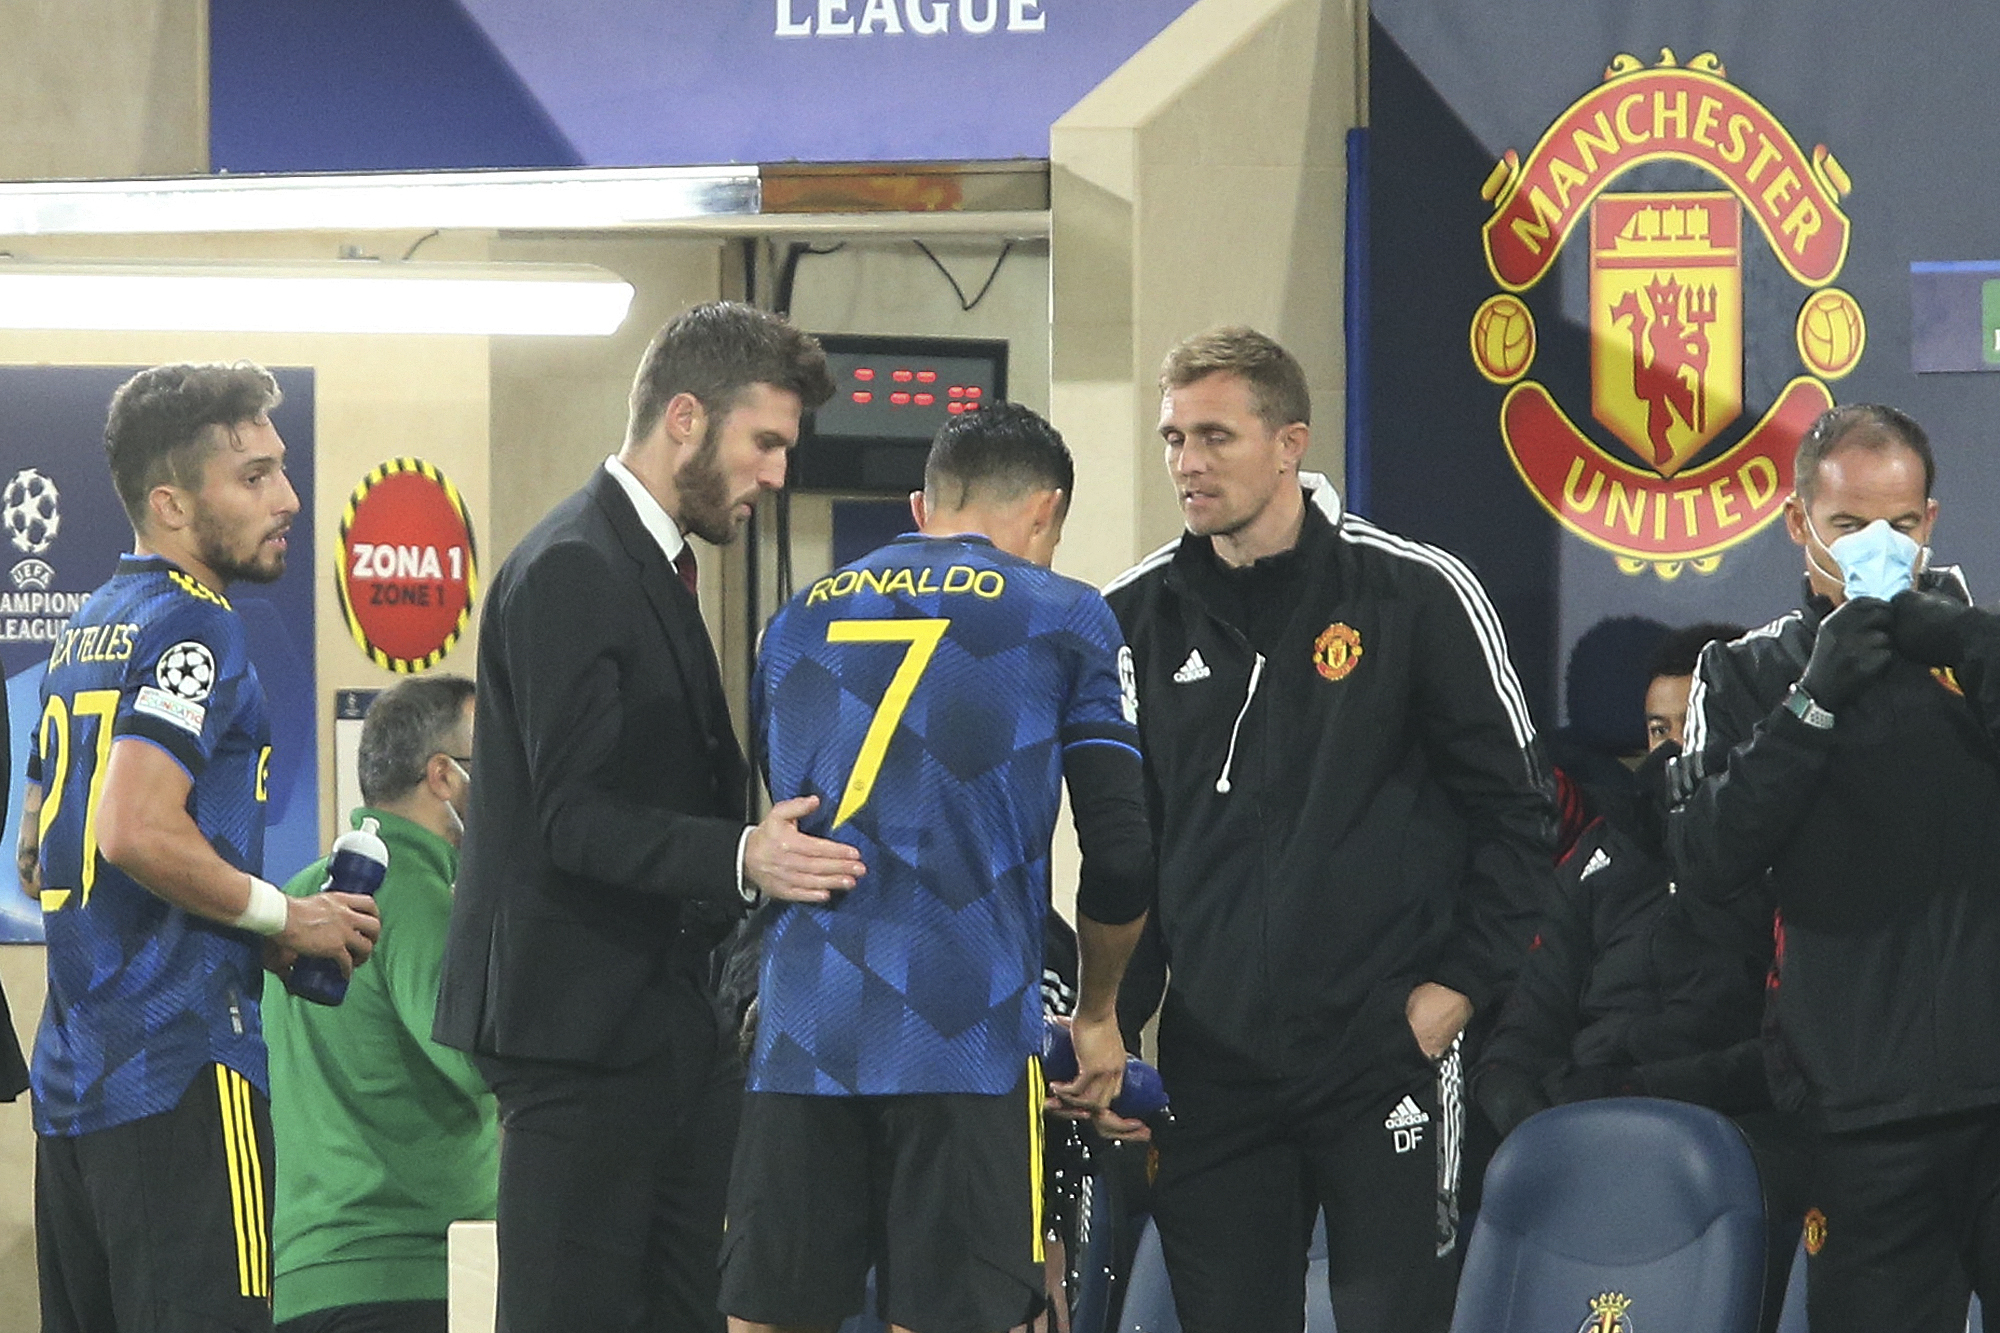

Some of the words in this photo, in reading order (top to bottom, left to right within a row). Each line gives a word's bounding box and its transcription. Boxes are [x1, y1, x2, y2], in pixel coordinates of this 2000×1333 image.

[774, 0, 1046, 35] LEAGUE
[1510, 90, 1824, 256] MANCHESTER
[1562, 454, 1779, 541] UNITED
[13, 564, 52, 584] UEFA
[352, 543, 443, 579] ZONA
[448, 545, 463, 580] 1
[370, 582, 430, 607] ZONE
[436, 583, 445, 606] 1
[805, 566, 1005, 607] RONALDO
[0, 618, 70, 640] EAGU
[77, 623, 140, 663] TELLES
[826, 618, 951, 831] 7
[39, 689, 121, 910] 27
[1385, 1112, 1430, 1129] adidas
[1394, 1126, 1423, 1153] DF
